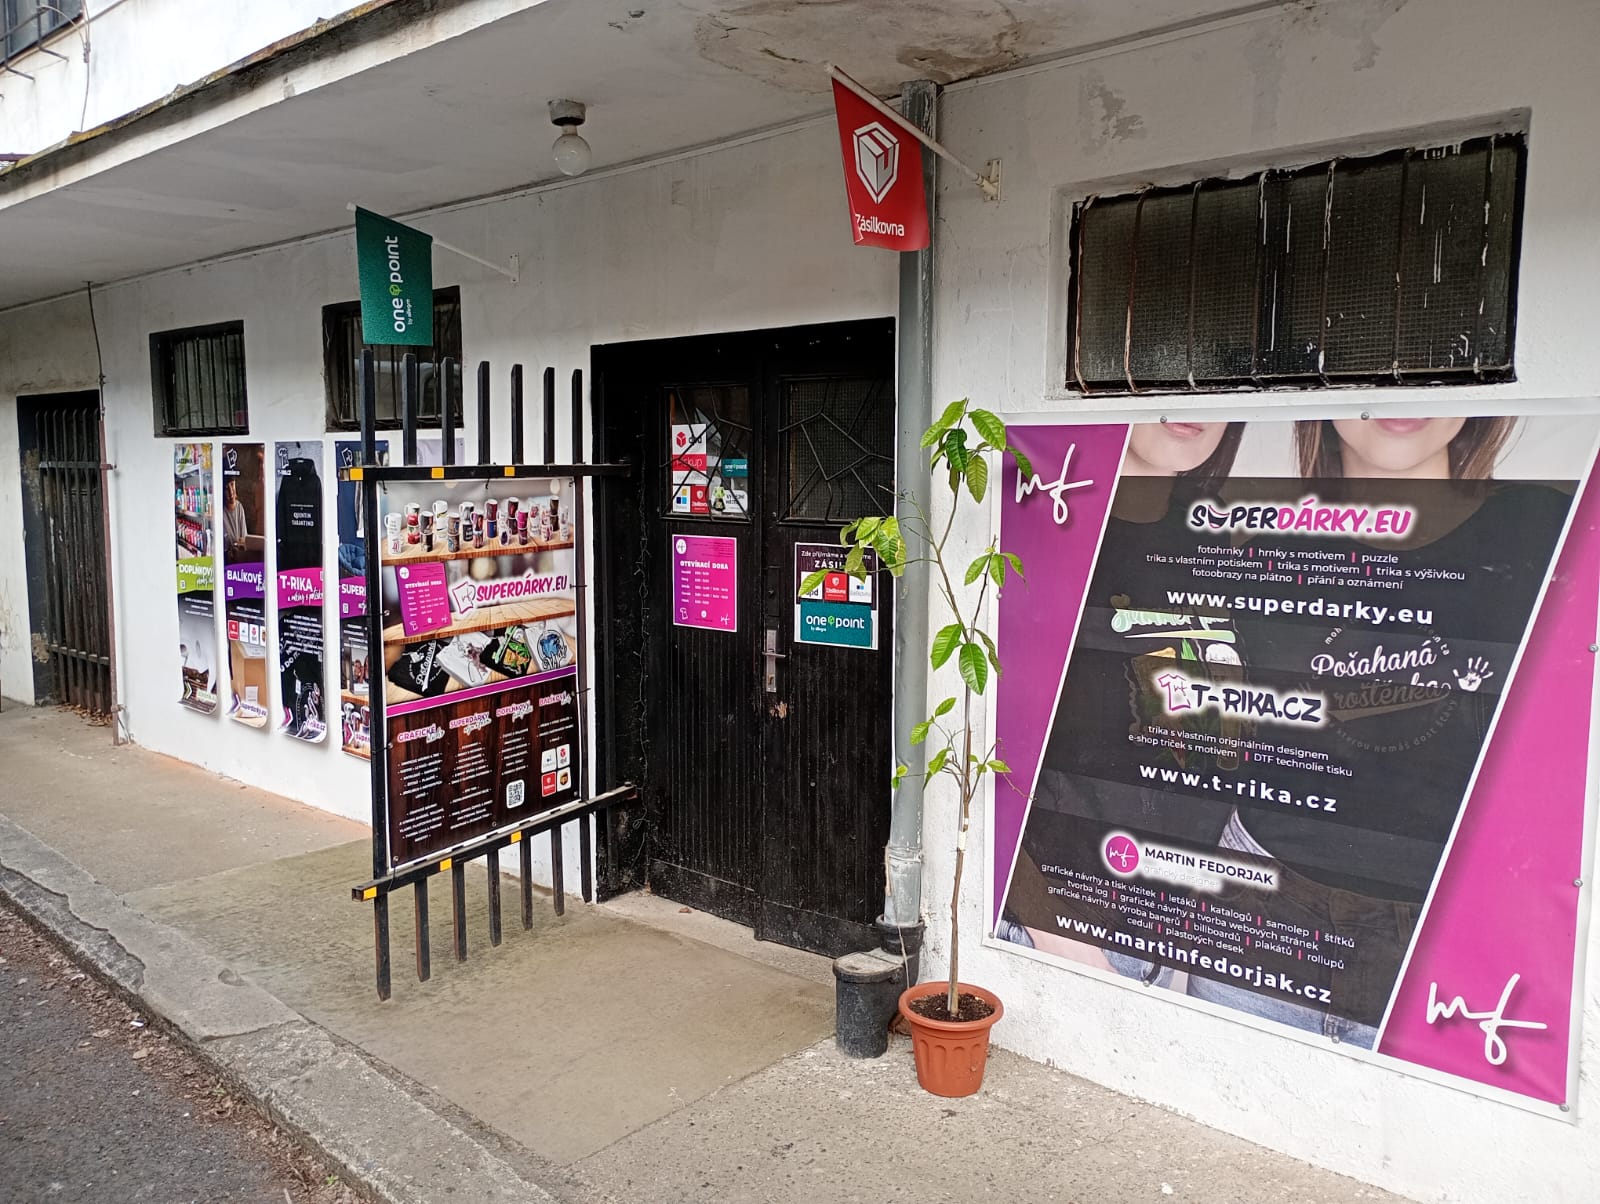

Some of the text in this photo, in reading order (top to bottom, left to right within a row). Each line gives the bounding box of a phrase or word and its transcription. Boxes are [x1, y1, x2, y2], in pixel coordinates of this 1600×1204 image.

[855, 214, 905, 237] Zásilkovna
[385, 235, 406, 333] one point
[812, 550, 839, 559] přijímáme
[1146, 554, 1167, 563] trika
[1175, 556, 1215, 566] vlastním
[1217, 559, 1263, 569] potiskem
[1277, 562, 1301, 571] trika
[1311, 564, 1360, 574] motivem
[1376, 567, 1402, 577] trika
[1405, 569, 1411, 577] s
[1414, 569, 1465, 581] výšivkou
[1198, 545, 1245, 557] fotohrnky
[1258, 548, 1288, 560] hrnky
[1297, 549, 1346, 561] motivem
[1361, 553, 1399, 564] puzzle
[227, 569, 262, 584] BALÍKOVÉ
[280, 575, 313, 592] T-RIKA
[341, 583, 367, 597] SUPER
[476, 573, 568, 602] SUPERDÁRKY.EU
[1192, 568, 1243, 581] fotoobrazy
[1259, 572, 1293, 583] plátno
[1307, 575, 1335, 586] přání
[1337, 578, 1344, 586] a
[1347, 579, 1404, 590] oznámení
[806, 615, 865, 629] one point
[1166, 591, 1433, 625] www.superdarky.eu
[1310, 640, 1438, 678] Pošahaná
[1190, 683, 1322, 723] T-RIKA.CZ
[1128, 734, 1159, 747] e-shop
[1160, 738, 1186, 750] triček
[1195, 745, 1237, 758] motivem
[1254, 753, 1274, 764] DTF
[1276, 756, 1325, 773] technolie
[1326, 765, 1353, 777] tisku
[1148, 725, 1168, 736] trika
[1177, 731, 1217, 743] vlastním
[1218, 737, 1275, 753] originálním
[1277, 745, 1329, 762] designem
[1139, 765, 1337, 813] www.t-rika.cz
[1145, 847, 1274, 886] MARTIN FEDORJAK
[1041, 863, 1355, 949] grafické návrhy a tisk vizitek letáků katalogů samolep štítků
[1067, 880, 1093, 893] tvorba
[1095, 884, 1108, 898] log
[1119, 893, 1156, 909] grafické
[1157, 903, 1187, 919] návrhy
[1197, 912, 1227, 927] tvorba
[1229, 922, 1278, 941] webových
[1279, 934, 1319, 951] stránek
[1047, 885, 1345, 970] grafické návrhy a výroba banerů billboardů plakátů rollupů
[1127, 917, 1245, 955] cedulí plastových desek
[1056, 914, 1332, 1004] www.martinfedorjak.cz
